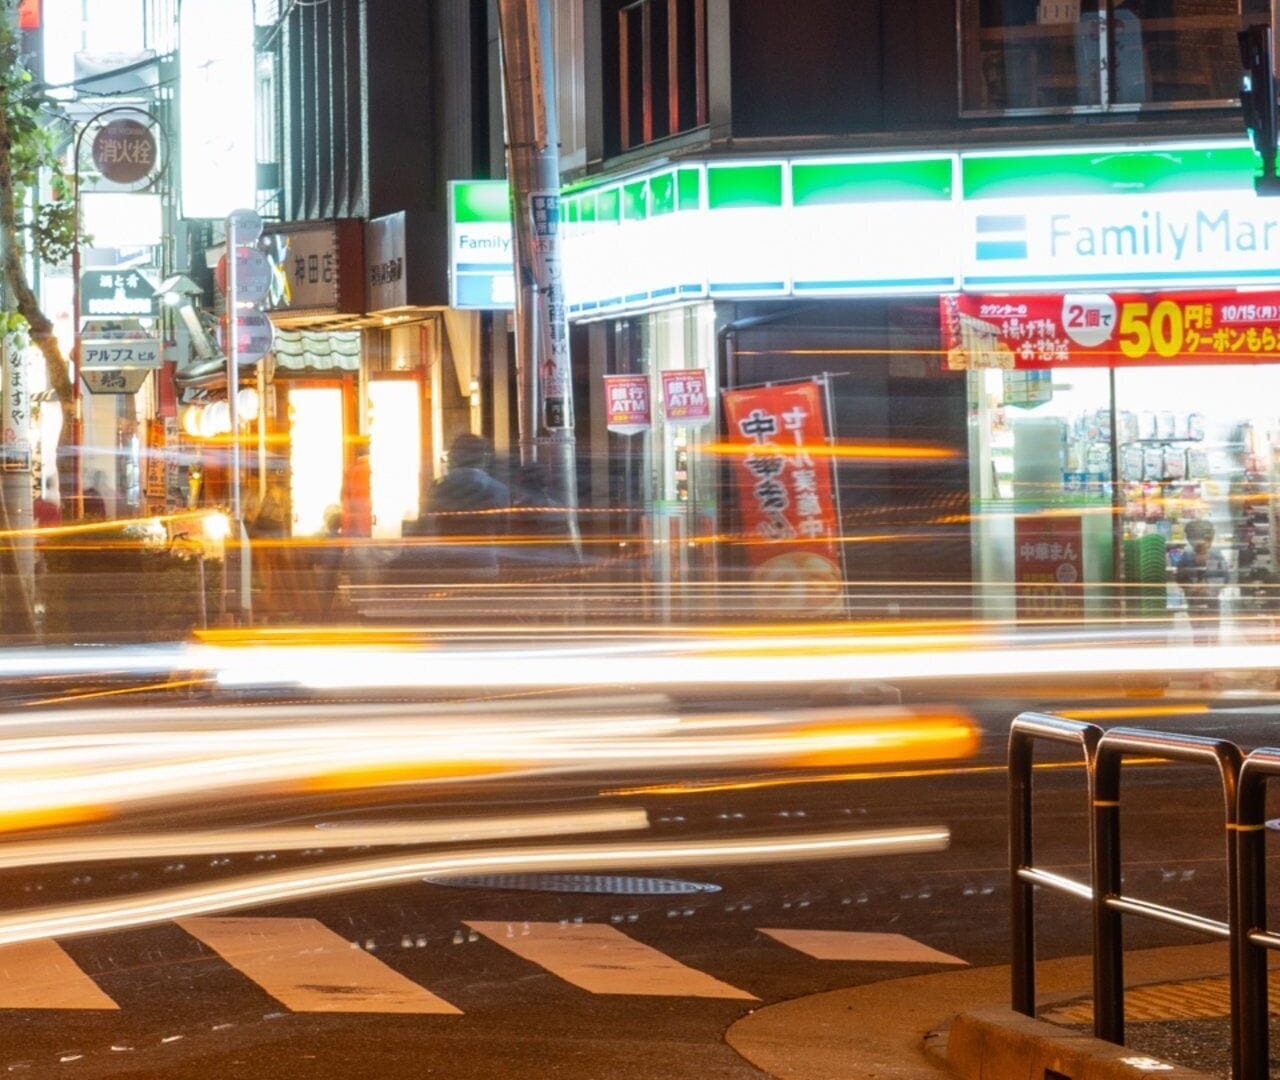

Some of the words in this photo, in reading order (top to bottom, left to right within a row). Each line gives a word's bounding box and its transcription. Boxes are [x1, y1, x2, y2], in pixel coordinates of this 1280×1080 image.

[100, 139, 151, 164] 消火栓
[459, 235, 509, 251] Family
[1051, 209, 1280, 261] FamilyMar
[295, 251, 334, 286] 神田店
[1221, 304, 1280, 321] 10/15(月)
[1002, 318, 1056, 339] 揚げ物
[86, 349, 133, 362] アルプス
[138, 352, 156, 362] ビル
[612, 400, 645, 412] ATM
[670, 393, 704, 407] ATM
